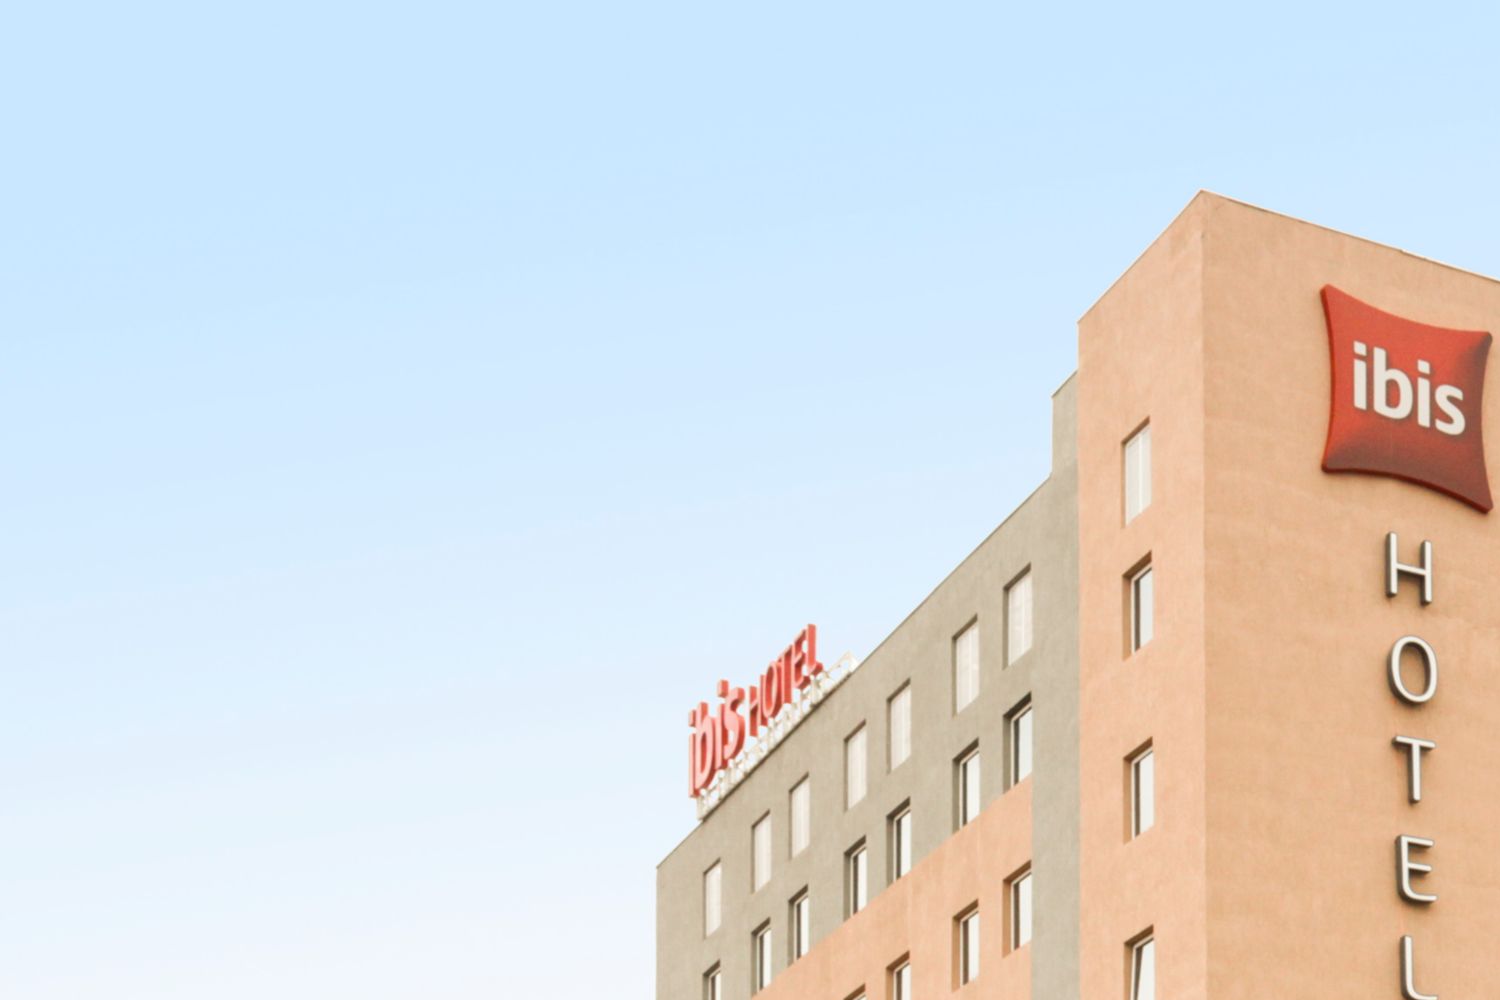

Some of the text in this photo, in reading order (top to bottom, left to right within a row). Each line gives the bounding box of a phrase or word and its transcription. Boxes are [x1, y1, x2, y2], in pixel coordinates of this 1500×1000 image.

[1353, 340, 1466, 436] ibis
[688, 623, 824, 798] ibis HOTEL
